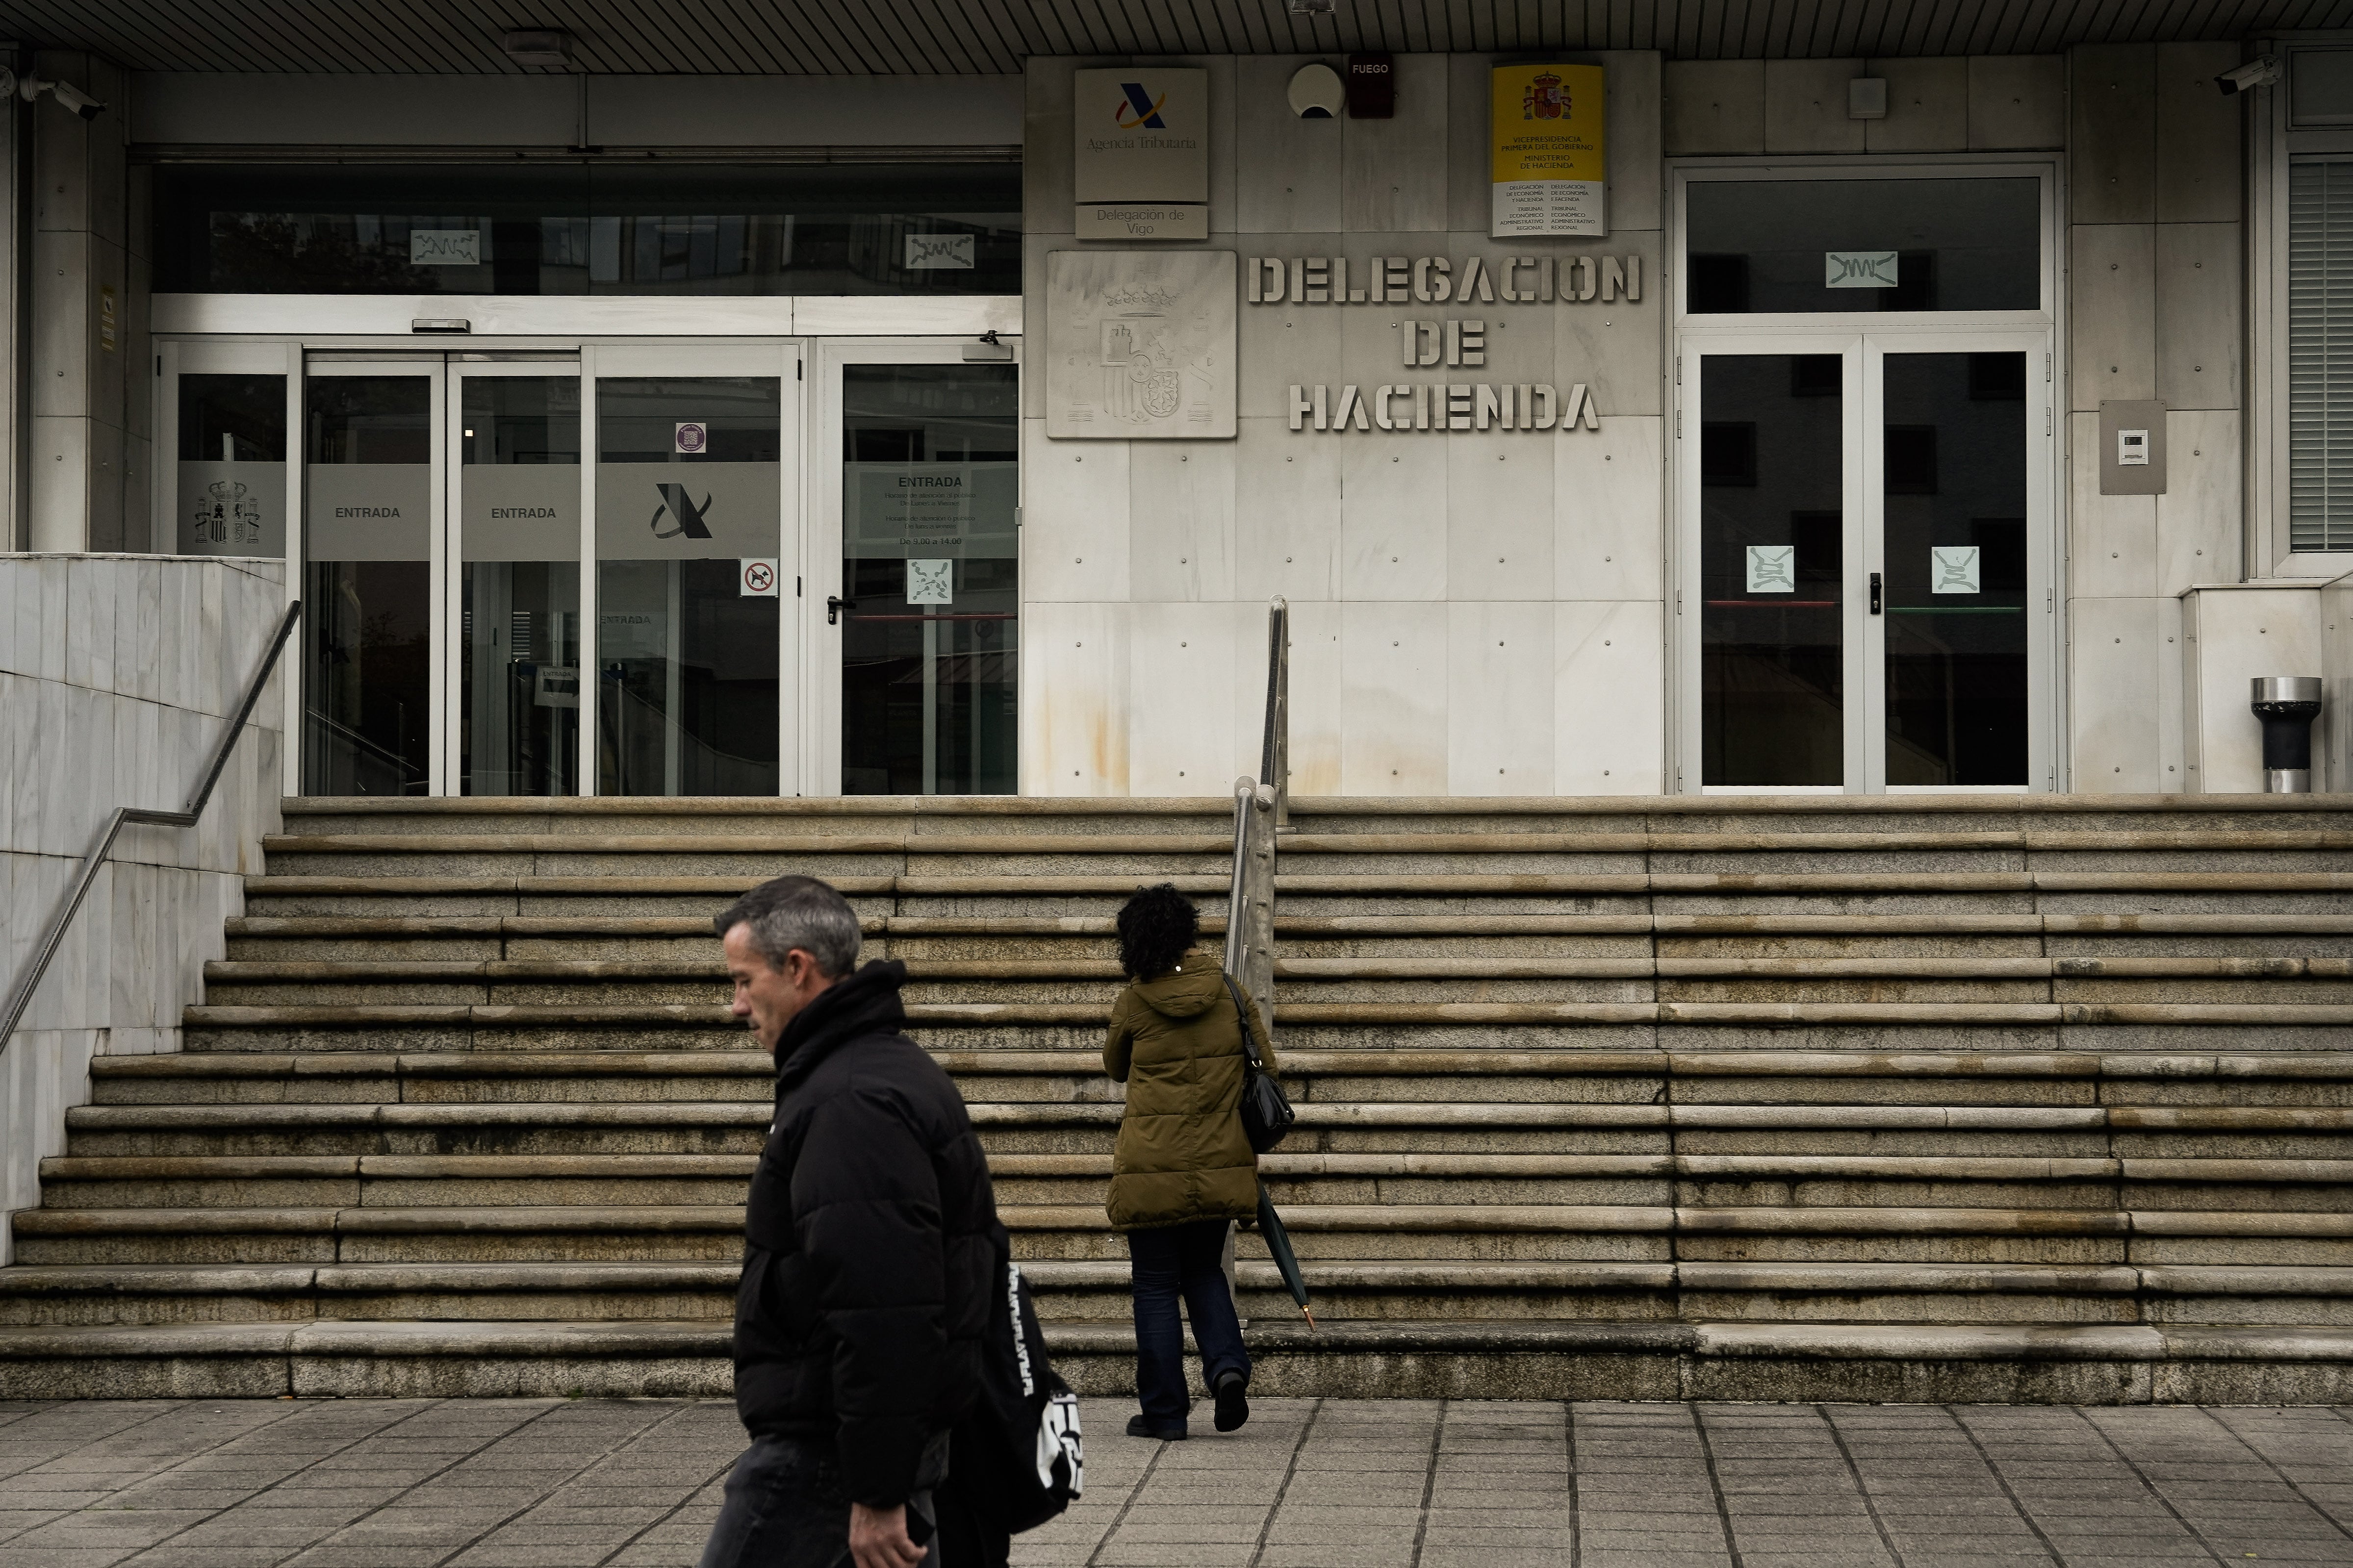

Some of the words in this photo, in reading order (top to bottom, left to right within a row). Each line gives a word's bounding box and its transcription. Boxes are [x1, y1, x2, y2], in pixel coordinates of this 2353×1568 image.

[1353, 65, 1388, 73] FUEGO
[1087, 137, 1134, 153] Agencia
[1138, 136, 1196, 149] Tributaria
[1097, 209, 1164, 222] Delegación
[1169, 210, 1184, 221] de
[1127, 223, 1154, 236] Vigo
[1248, 254, 1641, 303] DELEGACION
[1403, 319, 1485, 367] DE
[1289, 383, 1601, 431] HACIENDA
[899, 477, 962, 487] ENTRADA
[335, 507, 400, 518] ENTRADA
[491, 507, 557, 519] ENTRADA
